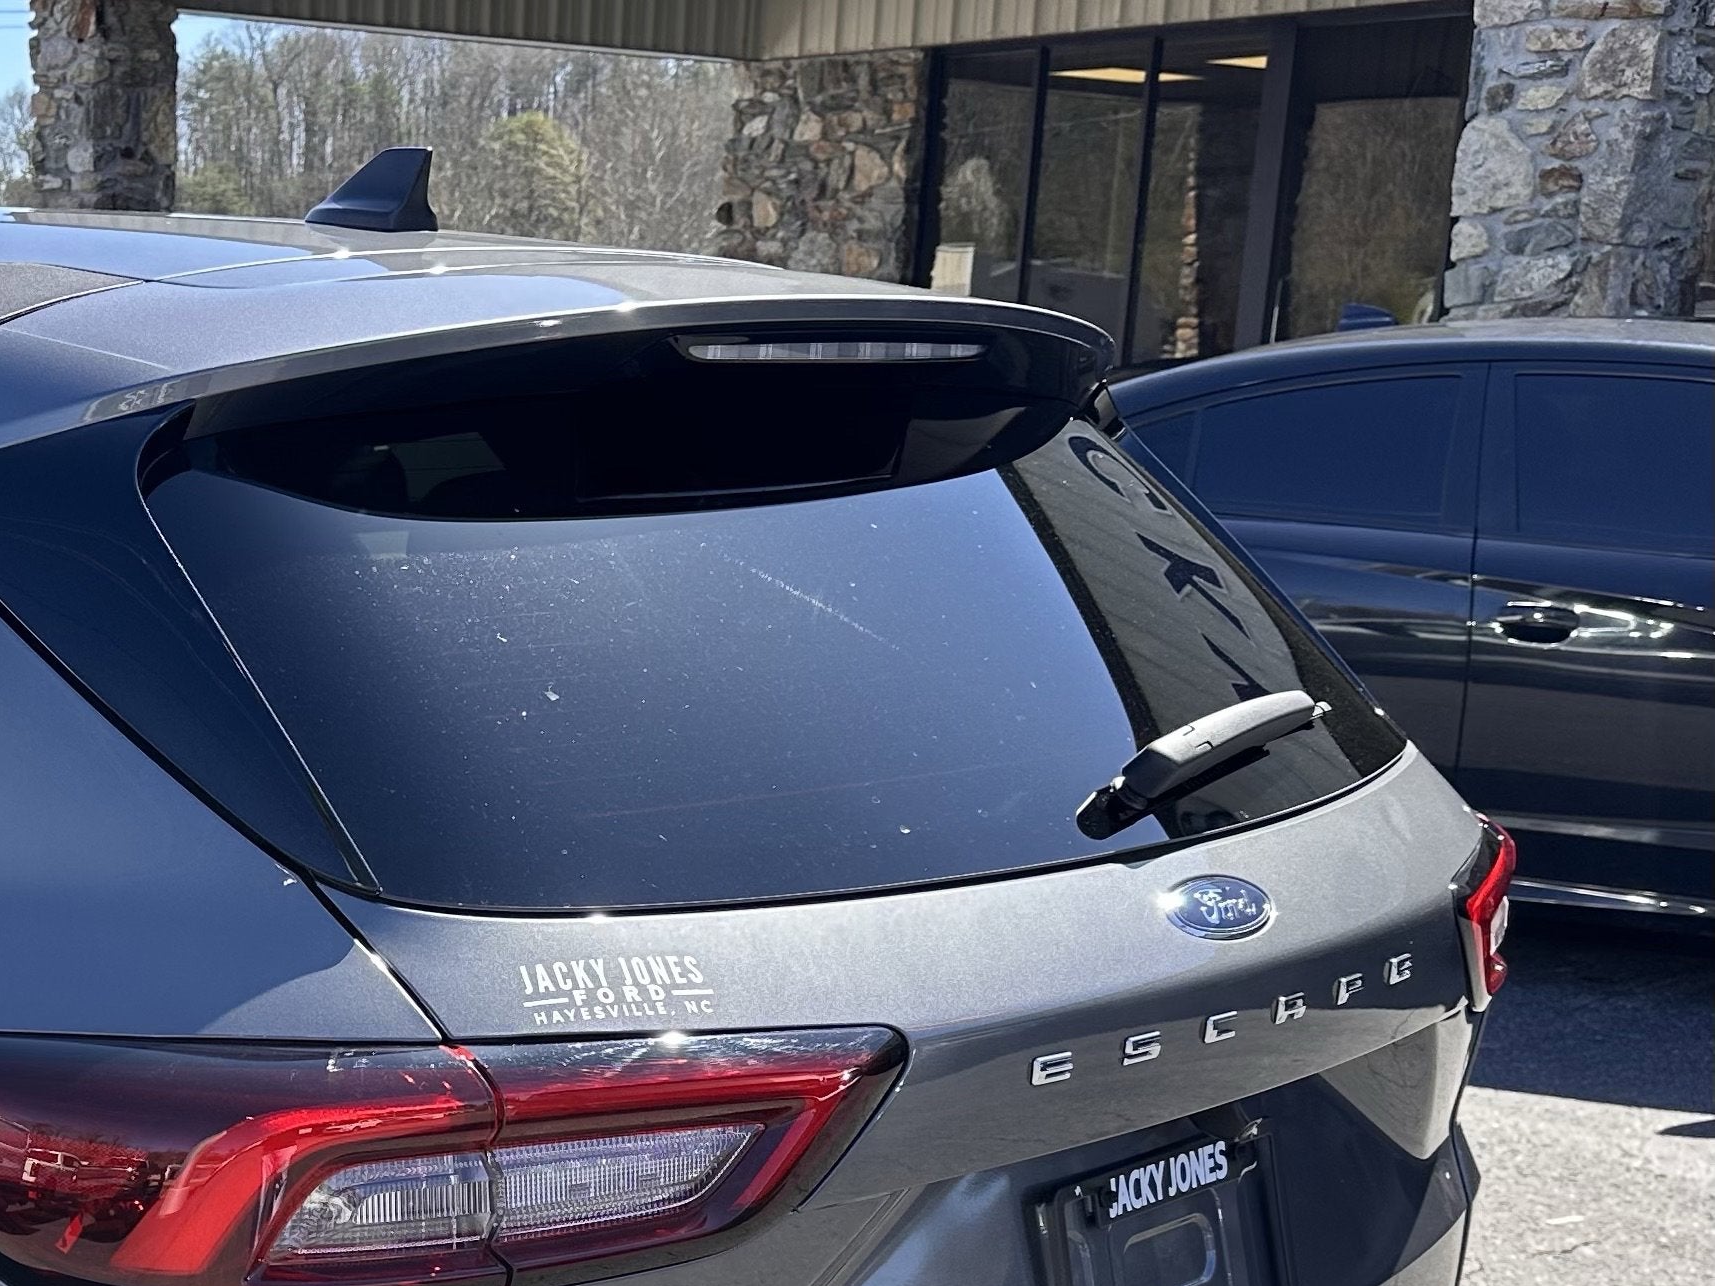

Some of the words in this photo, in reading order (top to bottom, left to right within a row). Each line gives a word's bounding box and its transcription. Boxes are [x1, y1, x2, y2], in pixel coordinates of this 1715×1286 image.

[1193, 887, 1258, 924] Ford
[519, 957, 609, 995] JACKY
[617, 955, 704, 986] JONES
[534, 1001, 676, 1026] HAYESVILLE,
[684, 1000, 714, 1014] NC
[572, 984, 666, 1006] FORD
[1029, 952, 1415, 1087] ESCAPE
[1108, 1160, 1166, 1219] JACKY
[1168, 1140, 1228, 1197] JONES
